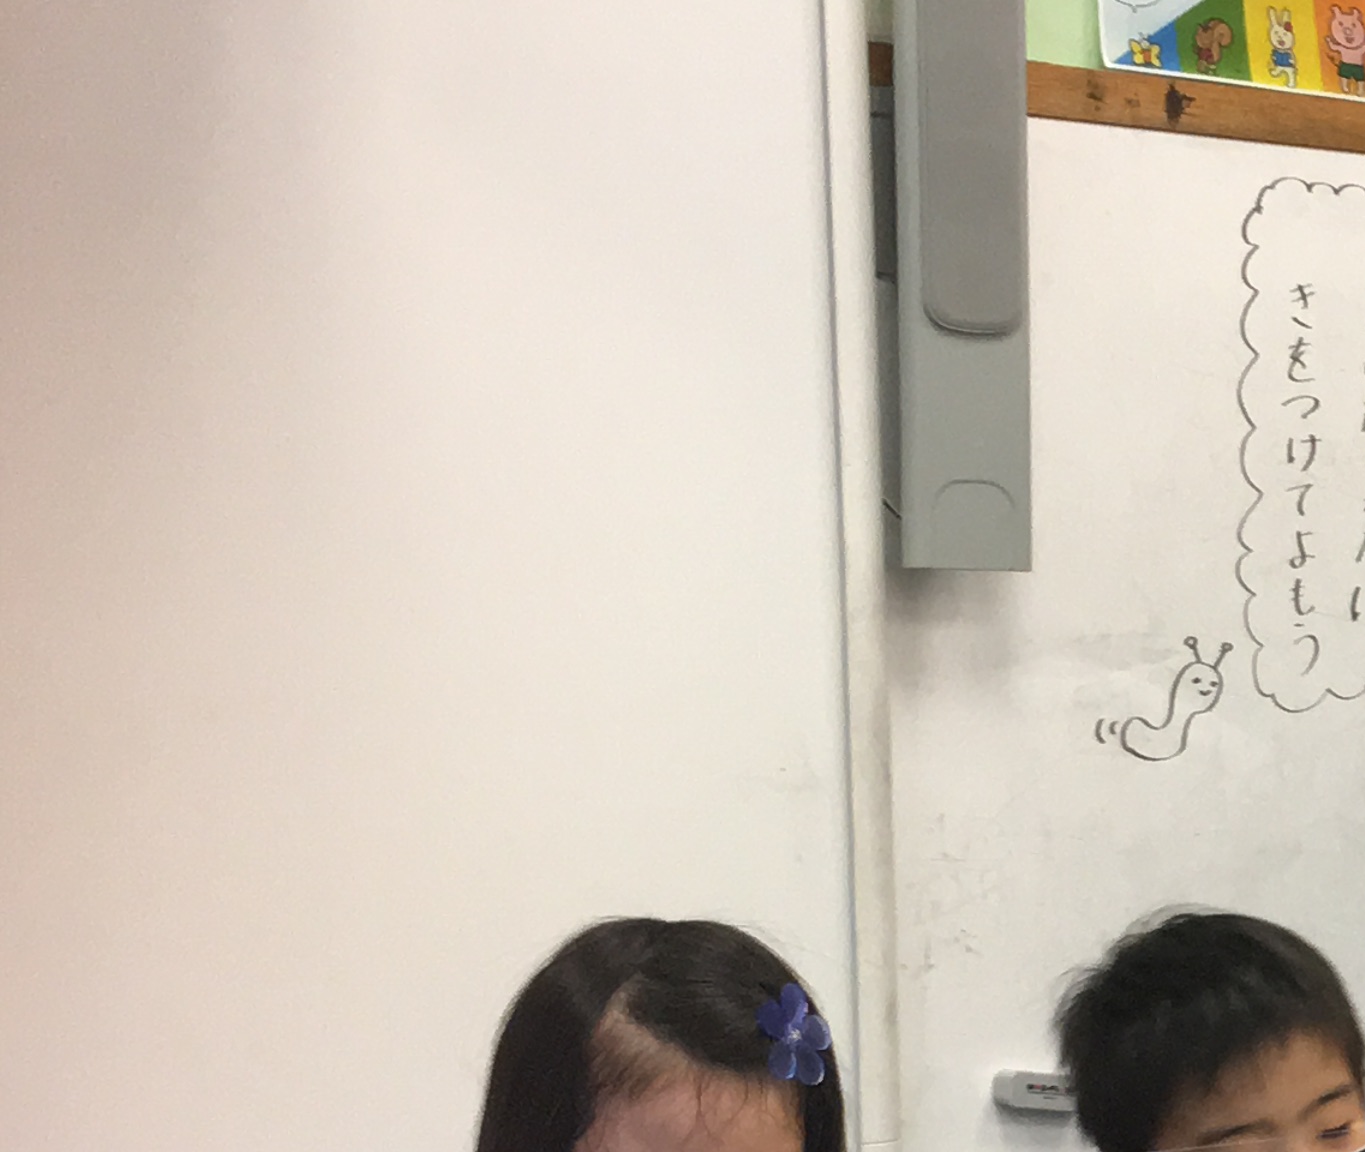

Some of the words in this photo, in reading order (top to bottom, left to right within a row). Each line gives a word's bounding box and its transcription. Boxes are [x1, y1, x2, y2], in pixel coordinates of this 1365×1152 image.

[1280, 283, 1323, 676] きをつけてよもう
